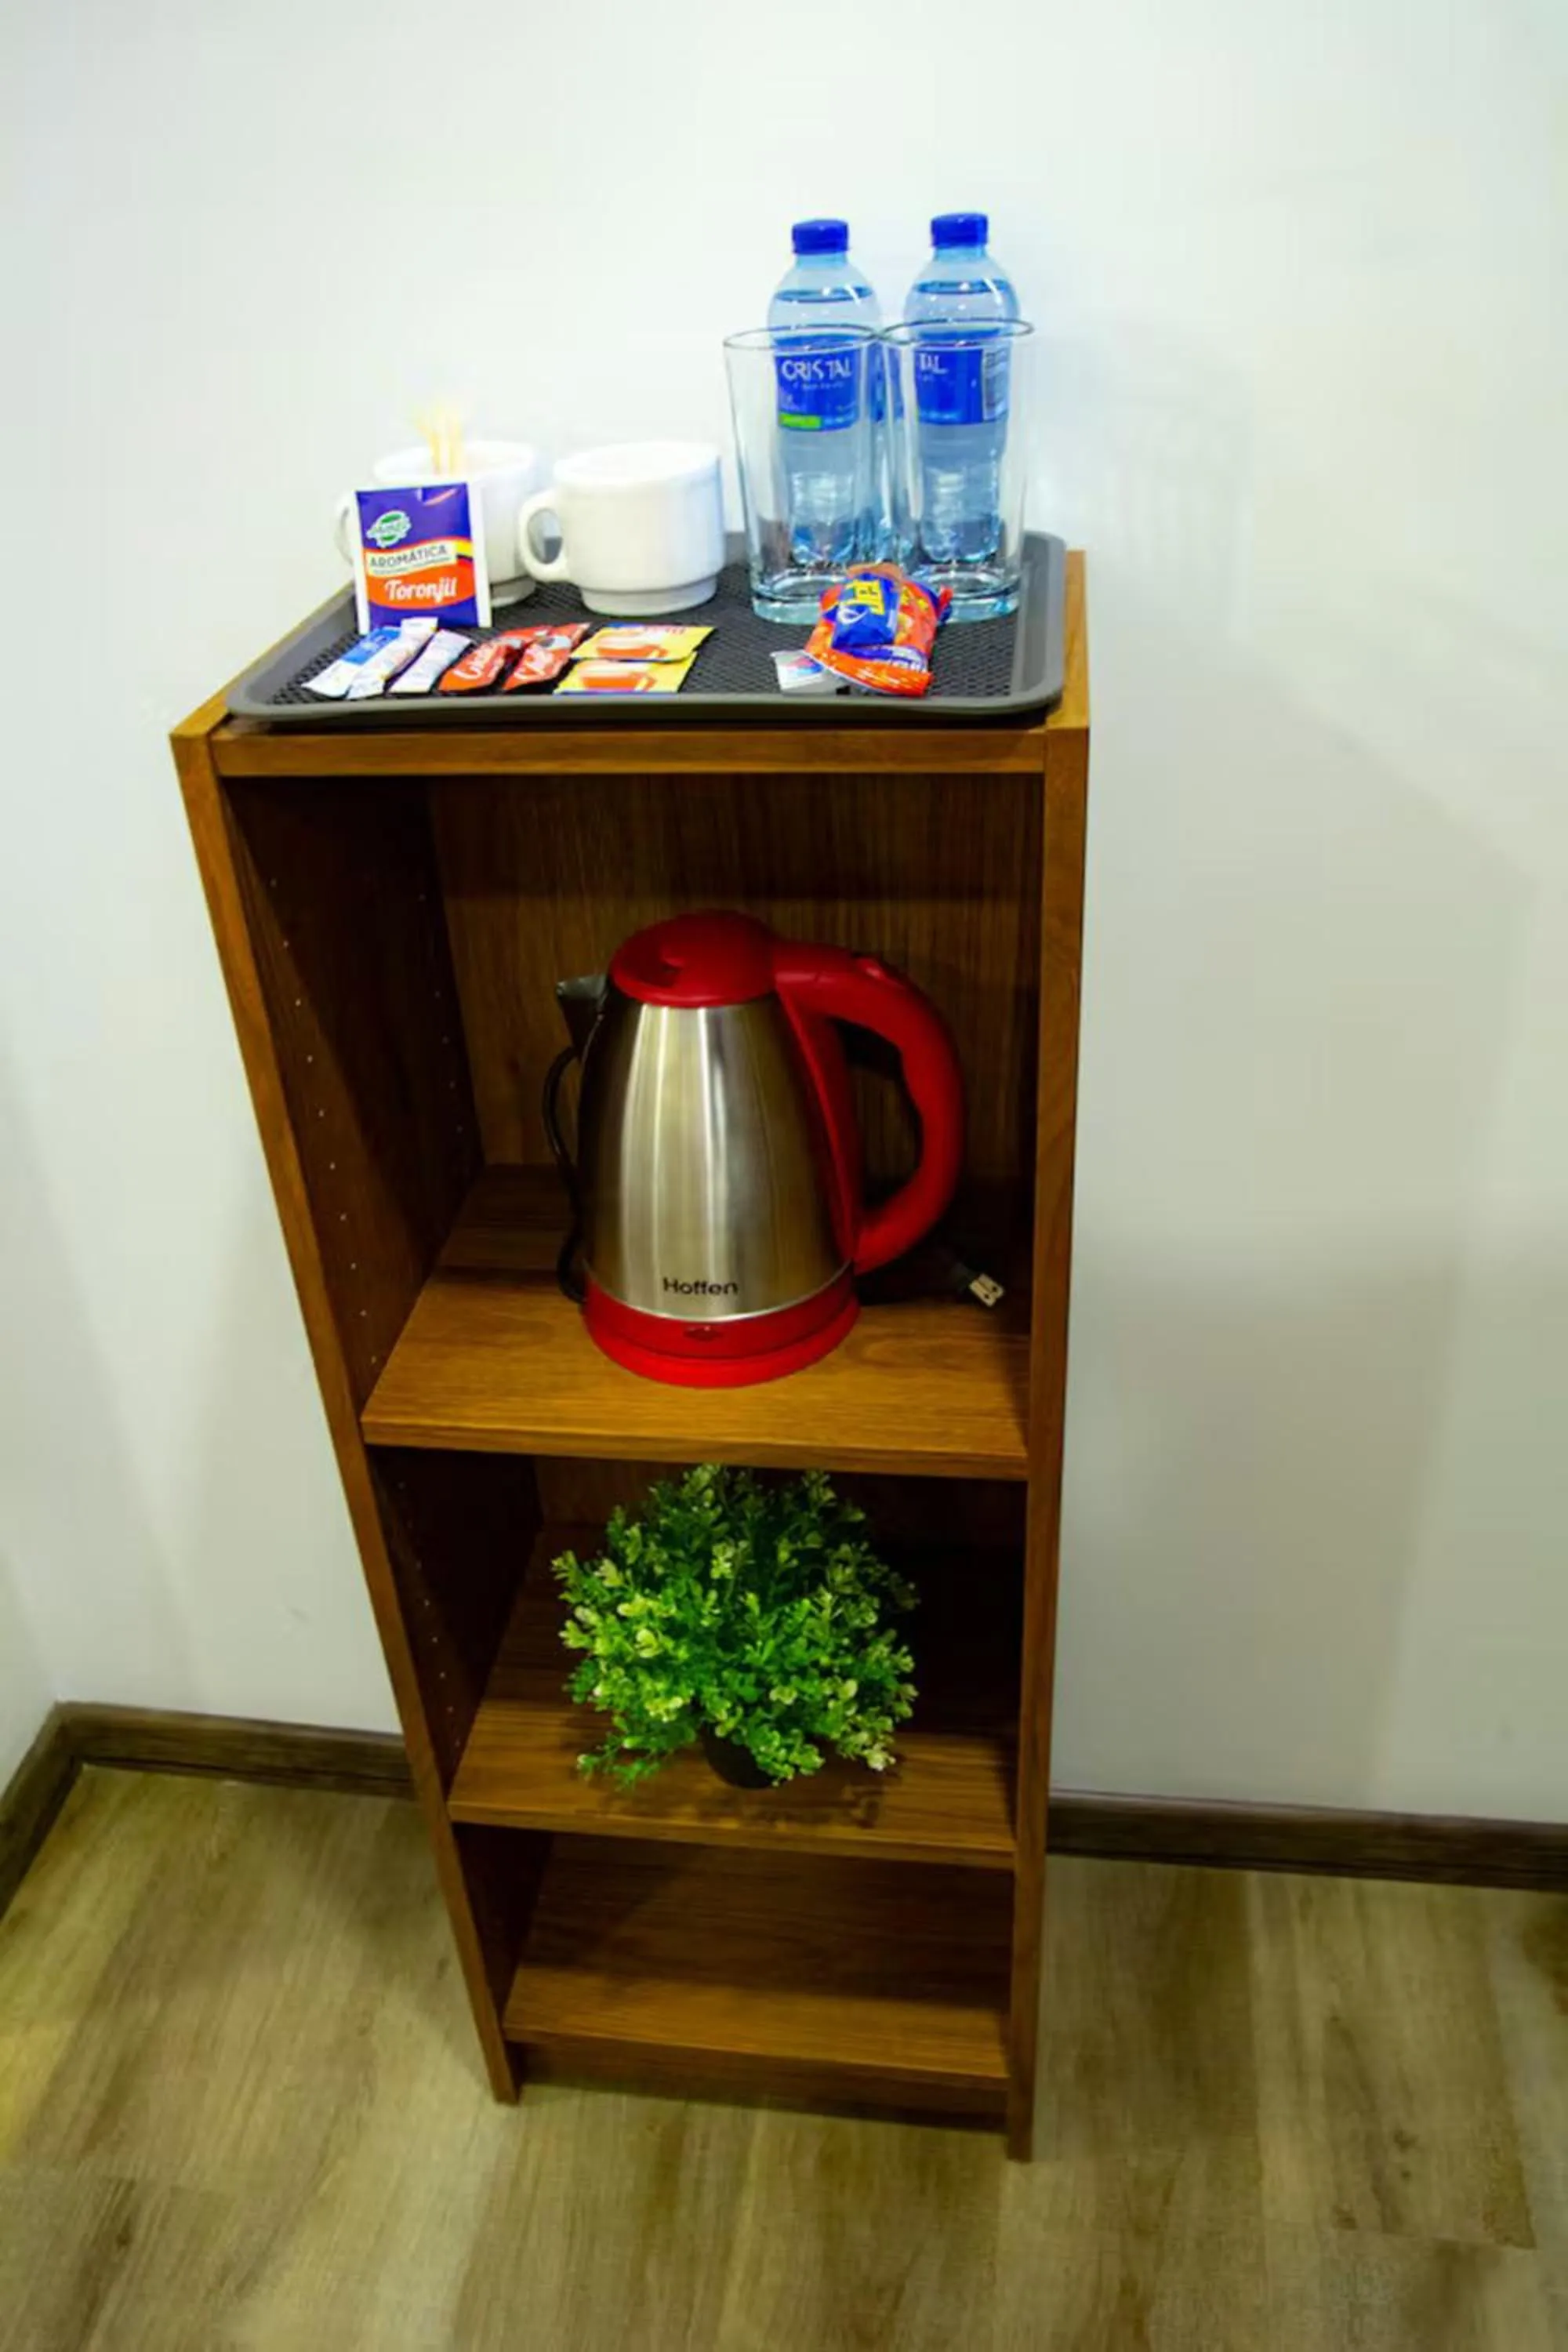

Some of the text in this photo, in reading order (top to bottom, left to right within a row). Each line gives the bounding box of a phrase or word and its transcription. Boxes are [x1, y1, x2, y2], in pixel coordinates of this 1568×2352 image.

[782, 358, 851, 381] CRISTAL
[385, 577, 457, 603] Toronjil
[663, 1277, 739, 1294] Hoffen
